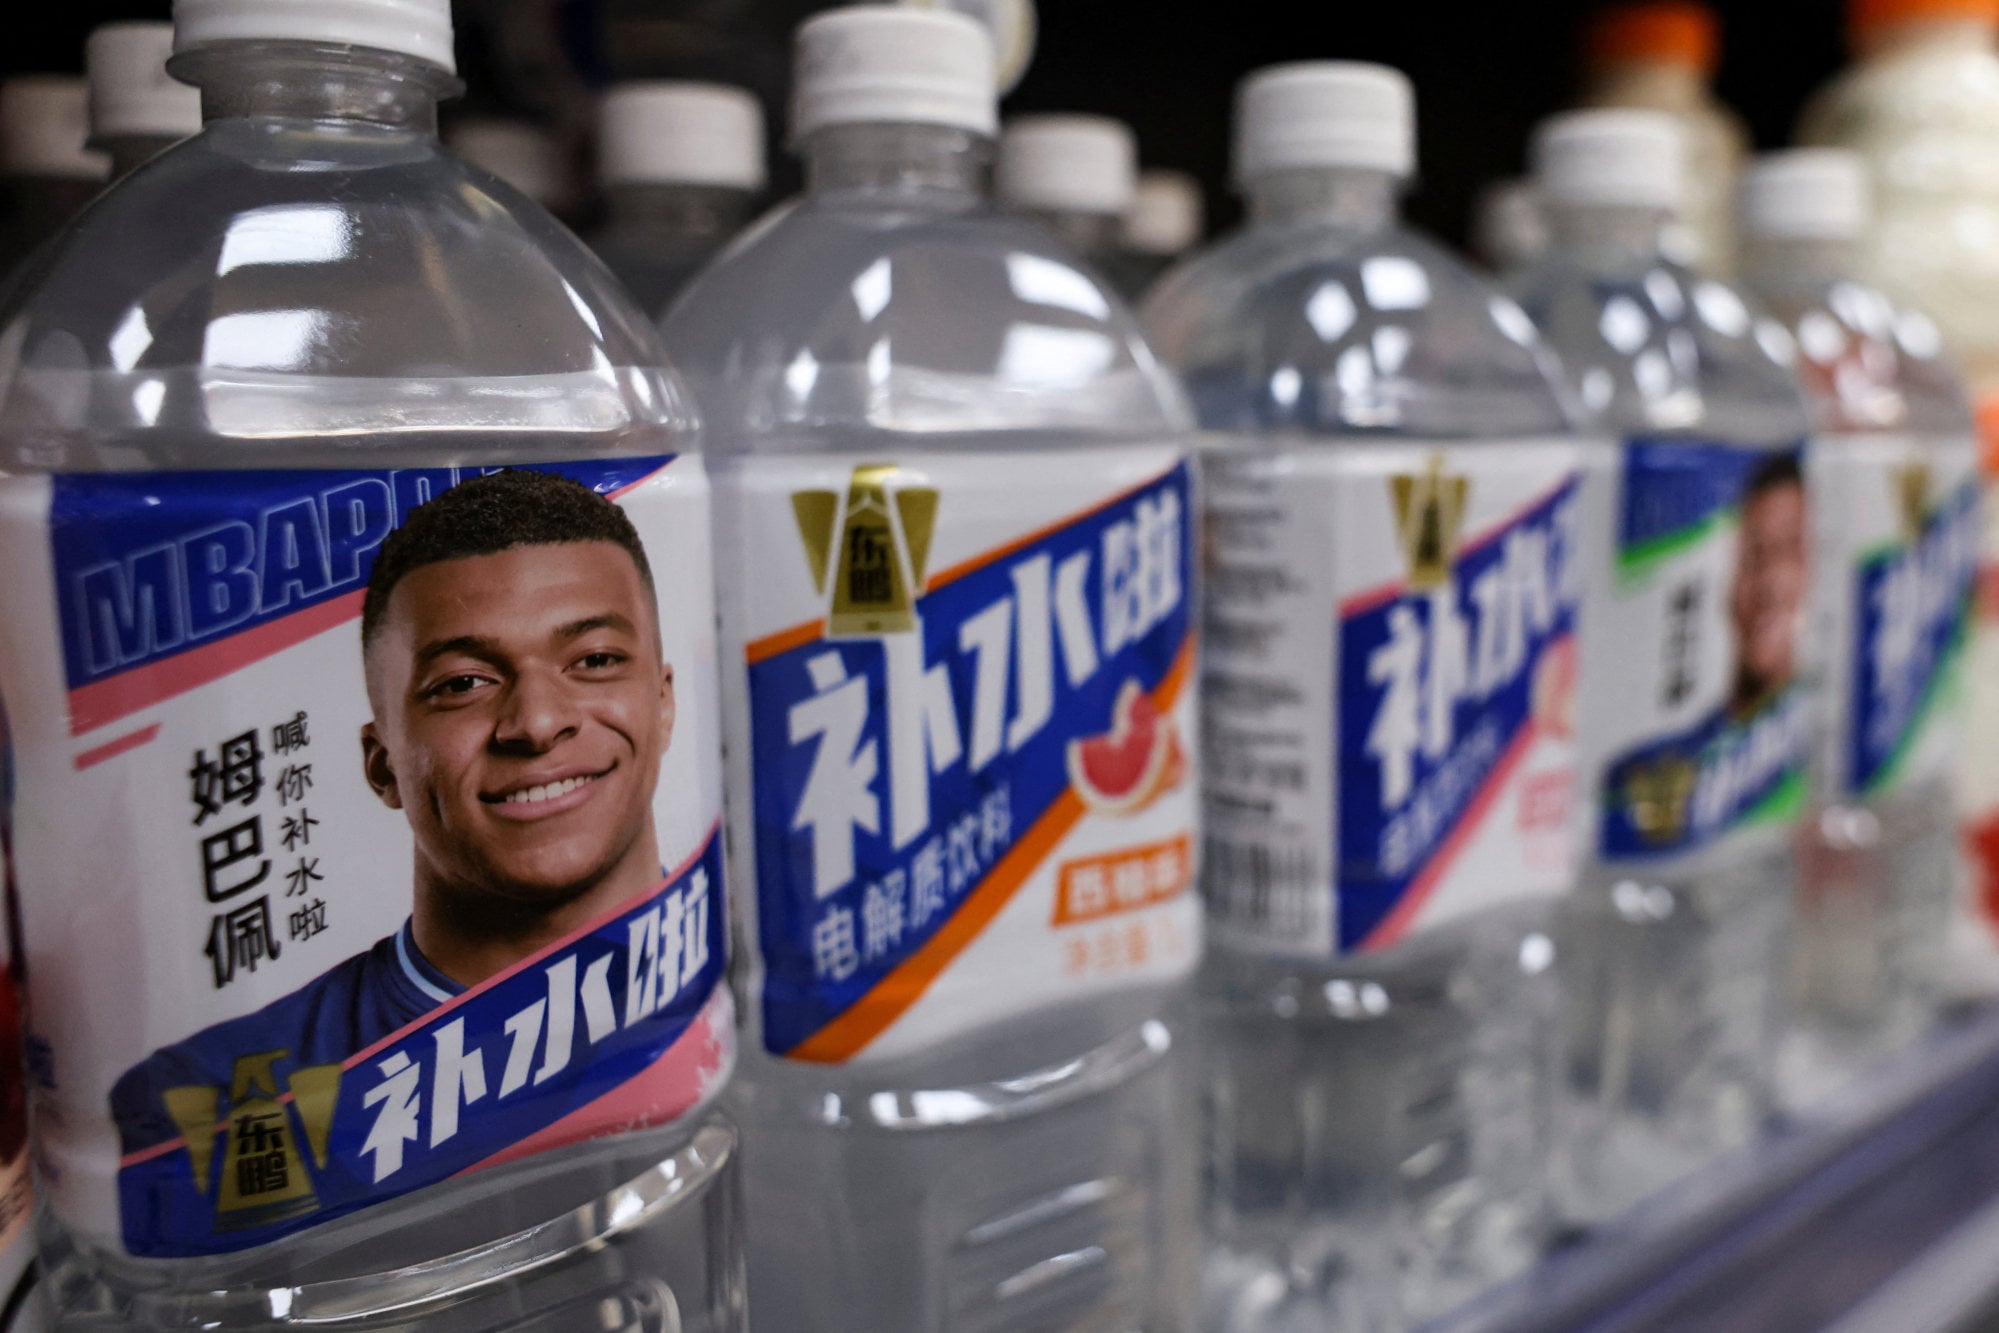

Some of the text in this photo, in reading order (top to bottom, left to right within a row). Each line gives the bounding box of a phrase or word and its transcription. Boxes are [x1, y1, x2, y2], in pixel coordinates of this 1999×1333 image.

[789, 487, 1182, 900] 补水啦
[188, 727, 282, 989] 姆巴佩
[271, 710, 330, 942] 喊你补水啦
[813, 781, 1011, 981] 电解质饮料
[359, 865, 709, 1184] 补水啦
[235, 1112, 289, 1196] 东鹏
